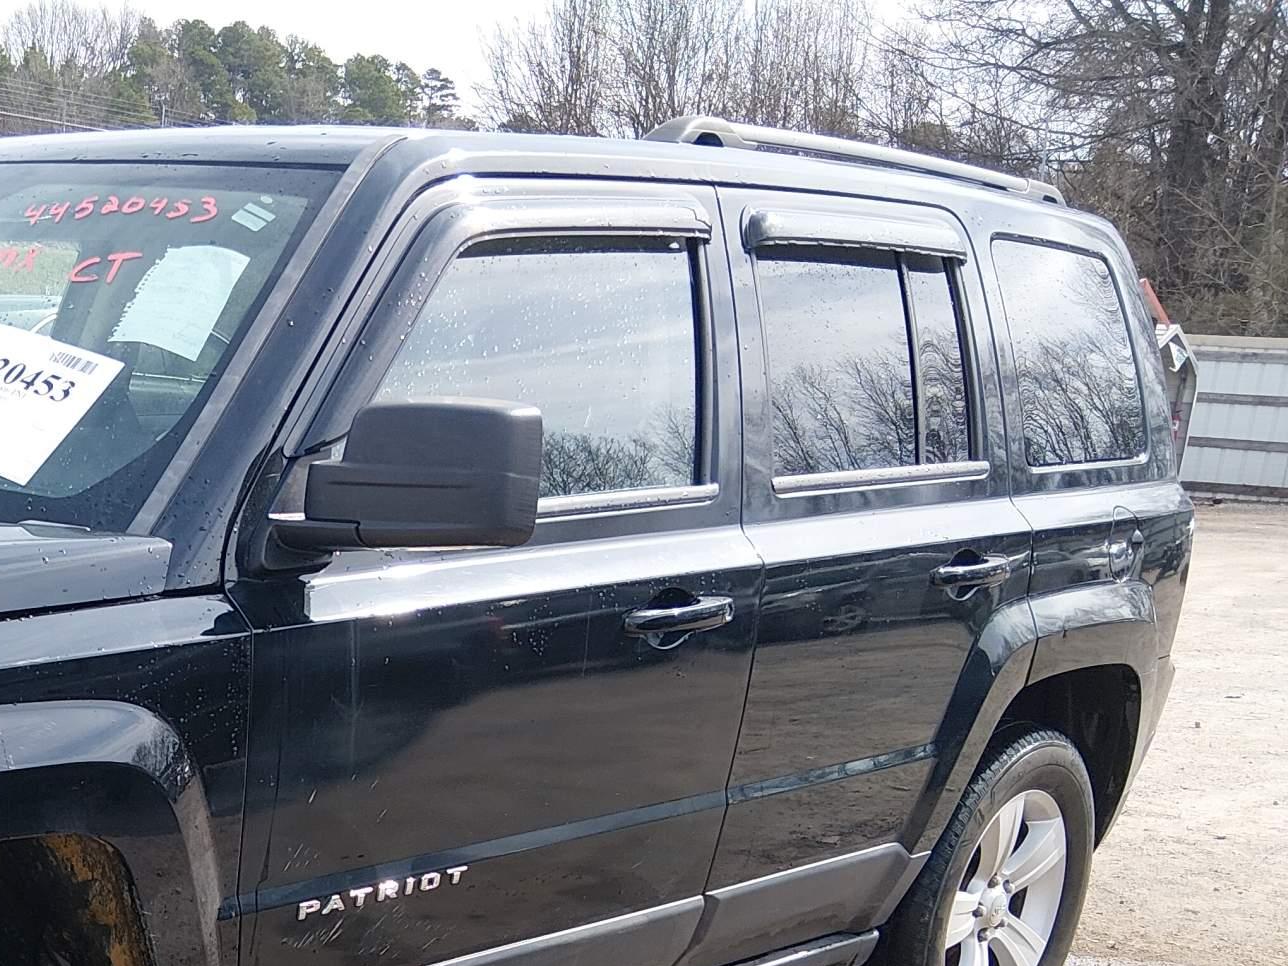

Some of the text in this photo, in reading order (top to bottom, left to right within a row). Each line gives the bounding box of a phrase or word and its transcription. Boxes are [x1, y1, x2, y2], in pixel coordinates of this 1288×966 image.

[24, 196, 219, 225] 44520453
[67, 251, 143, 284] CT
[297, 865, 469, 921] PATRIOT
